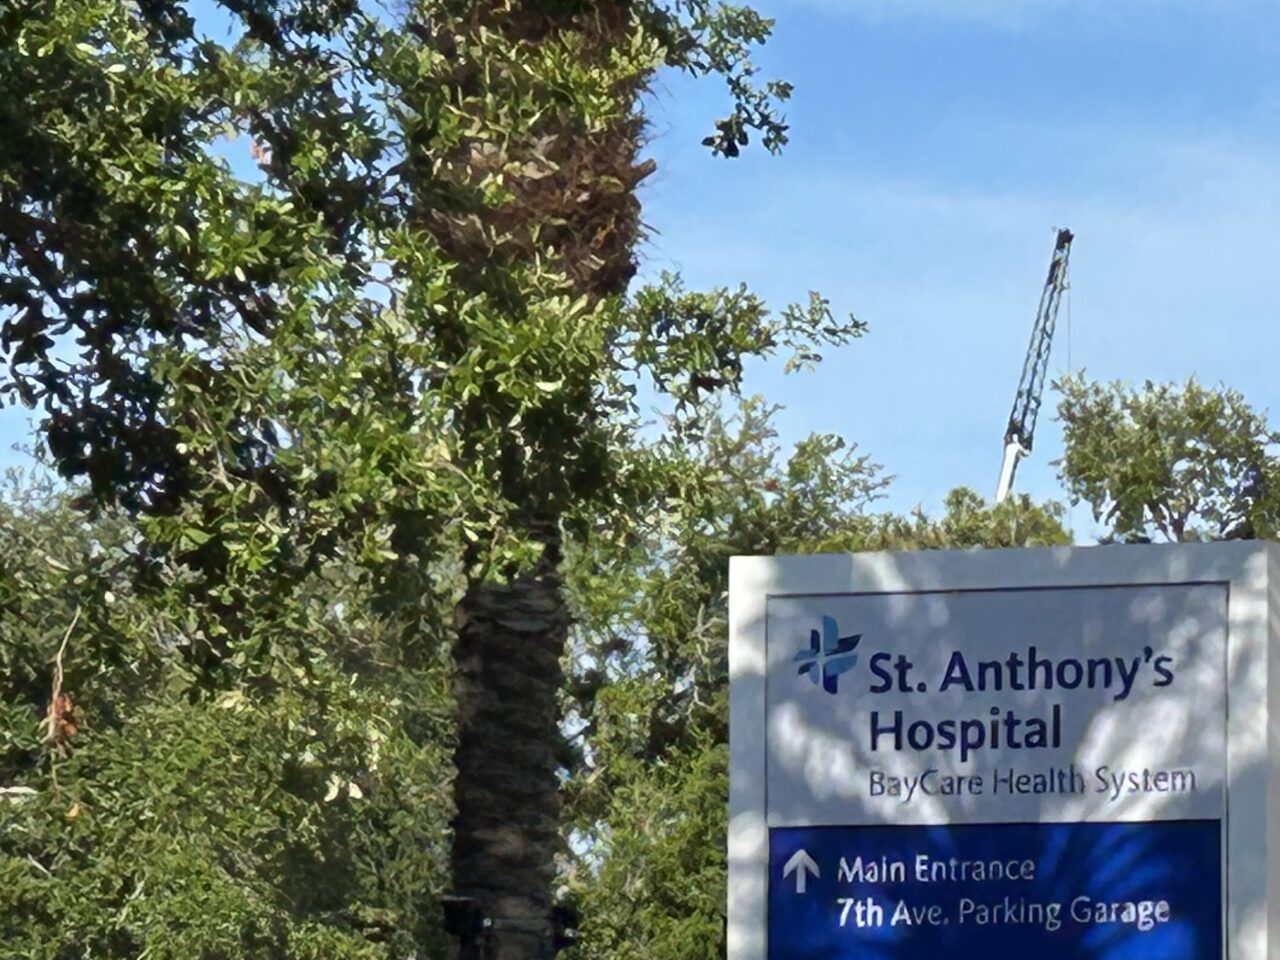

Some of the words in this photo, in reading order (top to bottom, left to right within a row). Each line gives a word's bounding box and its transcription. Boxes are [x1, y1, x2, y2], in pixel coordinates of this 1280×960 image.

[869, 652, 926, 693] St.
[940, 647, 1174, 701] Anthony's
[869, 704, 1061, 761] Hospital
[868, 771, 983, 801] BayCare
[993, 765, 1086, 796] Health
[1095, 766, 1197, 798] System
[837, 856, 905, 882] Main
[915, 855, 1034, 881] Entrance
[837, 898, 883, 927] 7th
[890, 898, 949, 926] Ave.
[960, 897, 1061, 930] Parking
[1070, 897, 1170, 931] Garage
